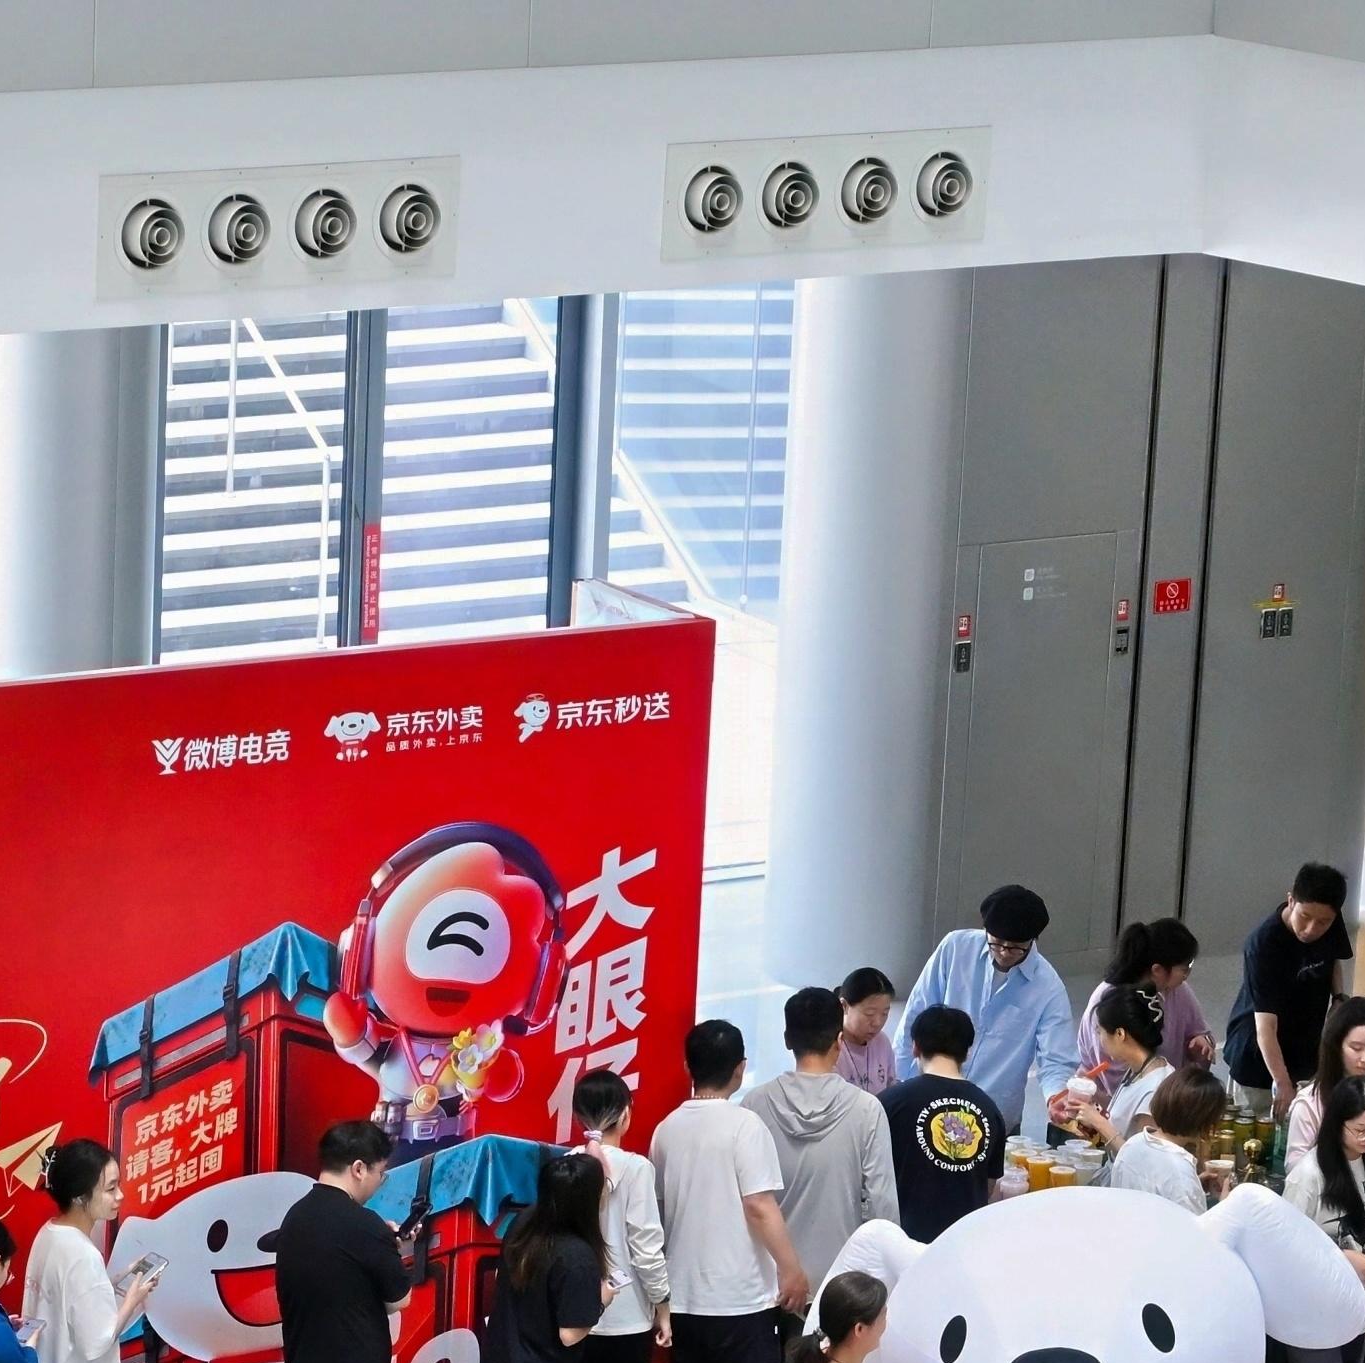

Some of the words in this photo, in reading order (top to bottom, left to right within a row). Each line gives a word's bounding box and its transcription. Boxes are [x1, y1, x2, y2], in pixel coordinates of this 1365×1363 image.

[386, 705, 484, 737] 京东外卖
[556, 692, 670, 730] 京东秒送
[183, 729, 291, 773] 微博电竞
[135, 1079, 232, 1146] 京东外卖
[917, 1107, 930, 1124] ALL
[930, 1098, 982, 1115] SKECHERS
[138, 1144, 224, 1204] 1元起囤
